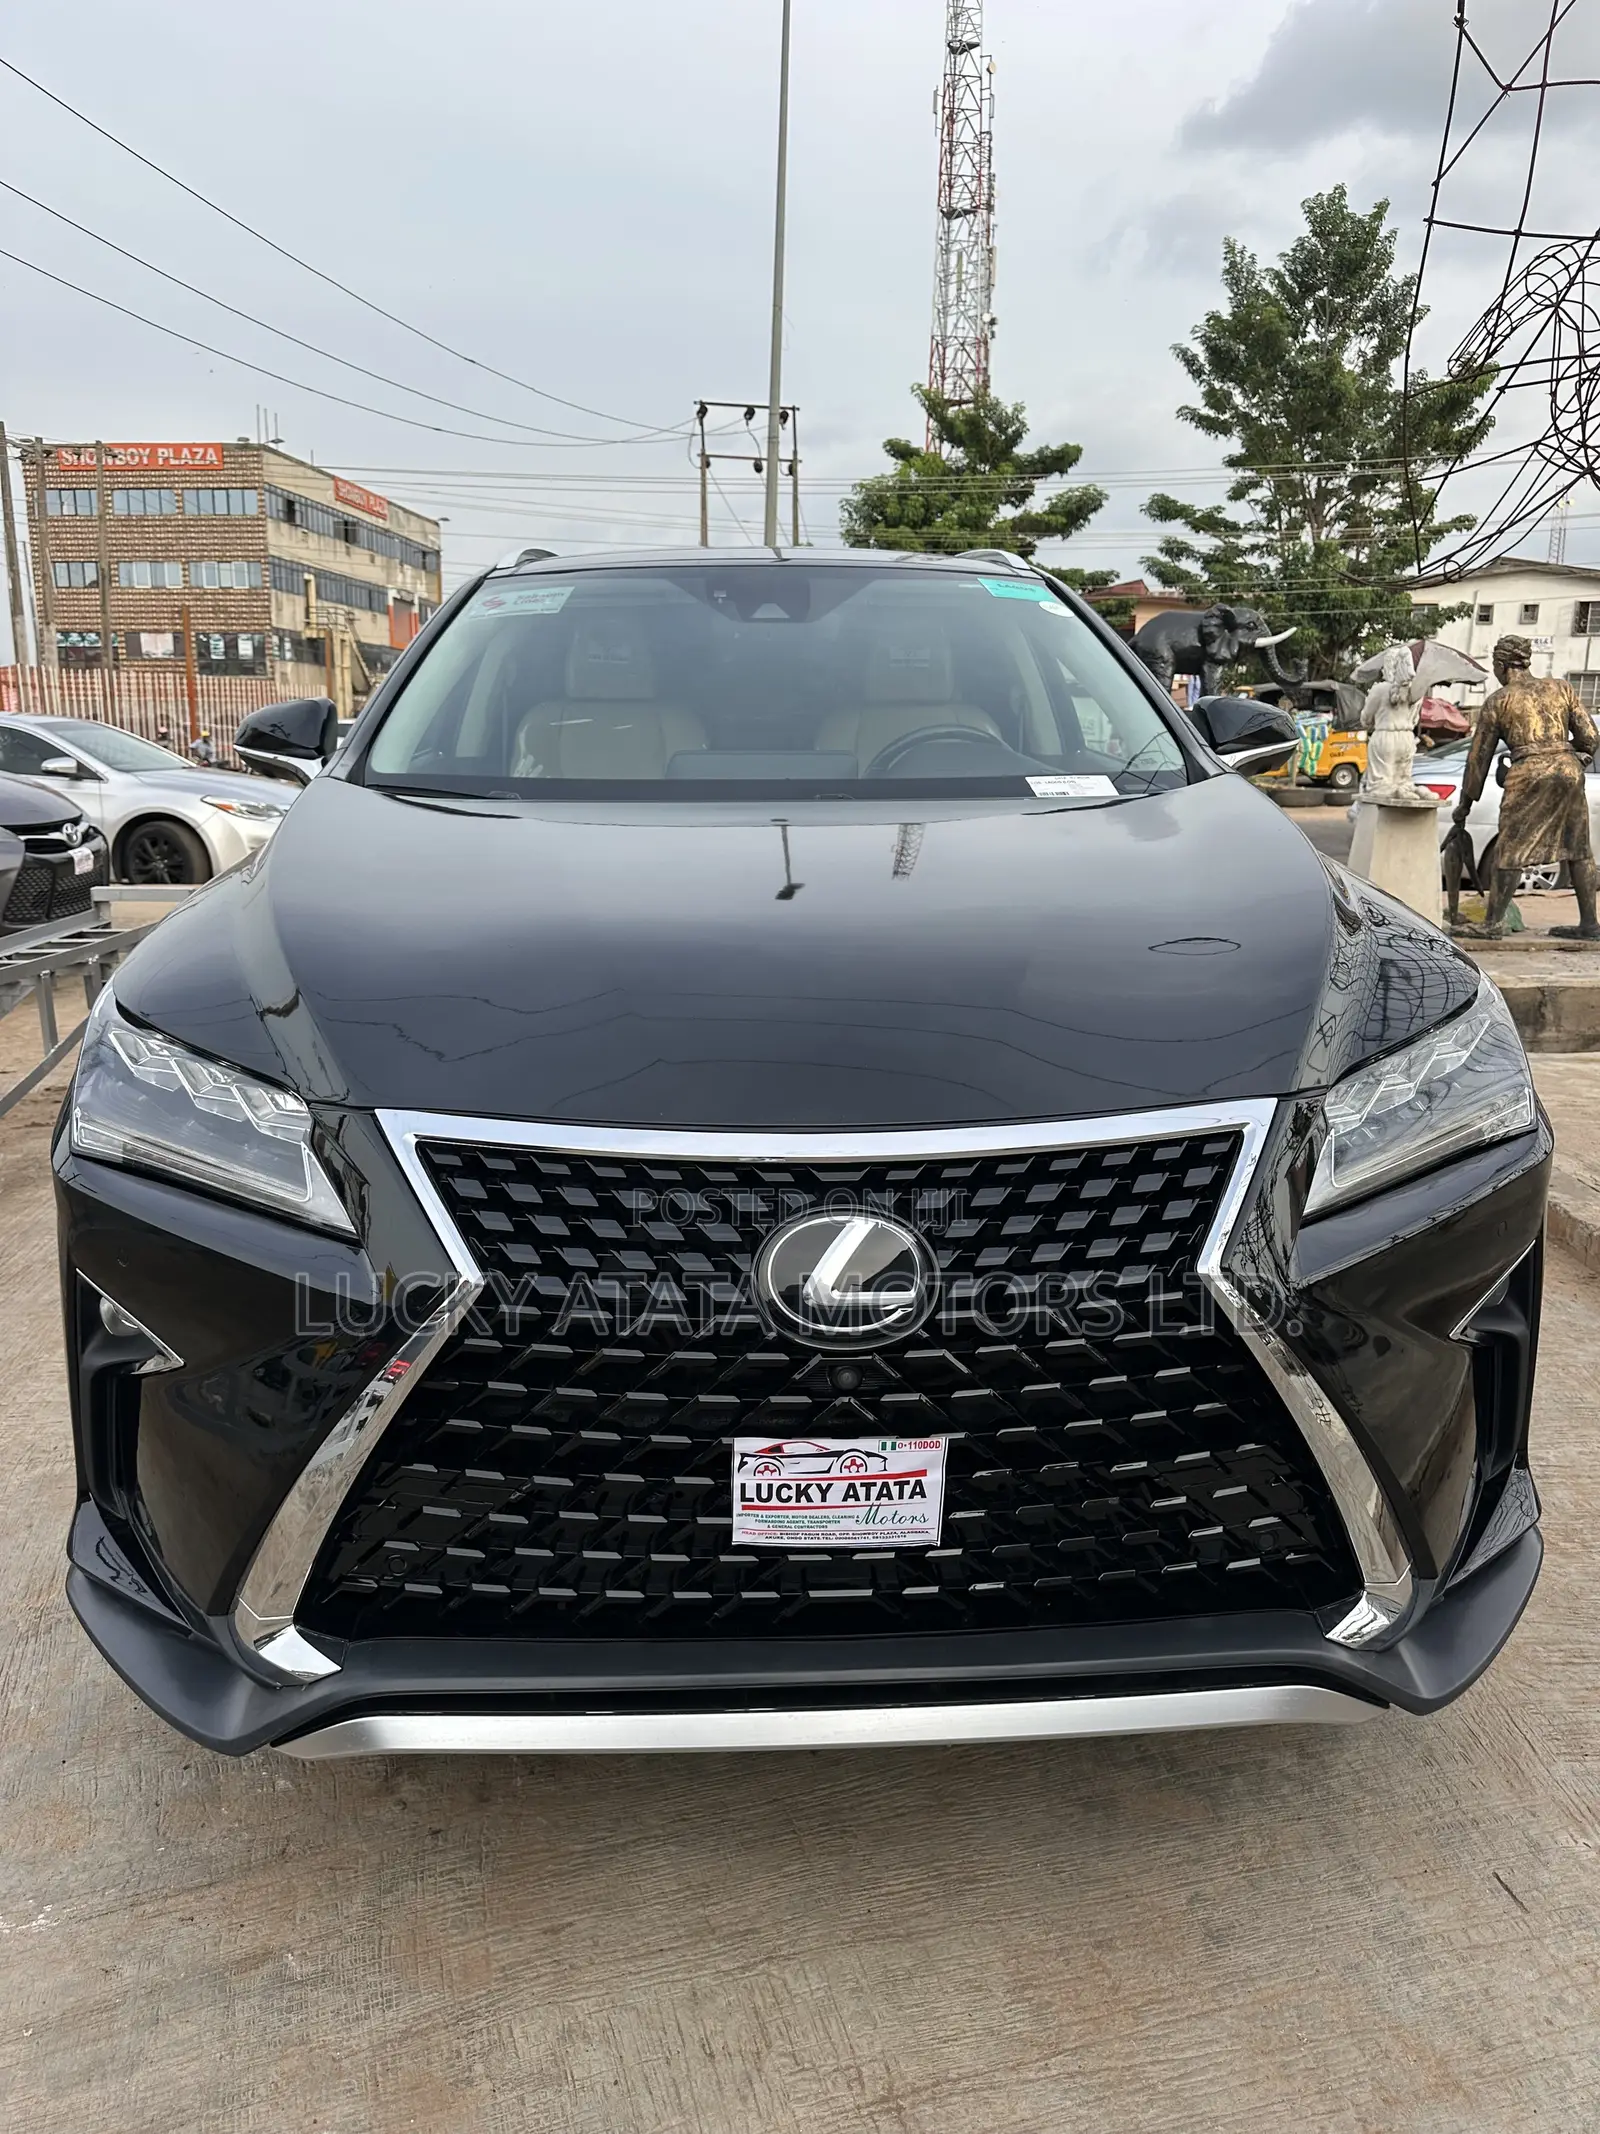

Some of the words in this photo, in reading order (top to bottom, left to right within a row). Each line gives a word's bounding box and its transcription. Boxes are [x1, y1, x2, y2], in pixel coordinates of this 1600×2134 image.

[157, 447, 219, 466] PLAZA
[739, 1482, 834, 1503] LUCKY
[841, 1479, 927, 1502] ATATA
[855, 1502, 929, 1526] Motors
